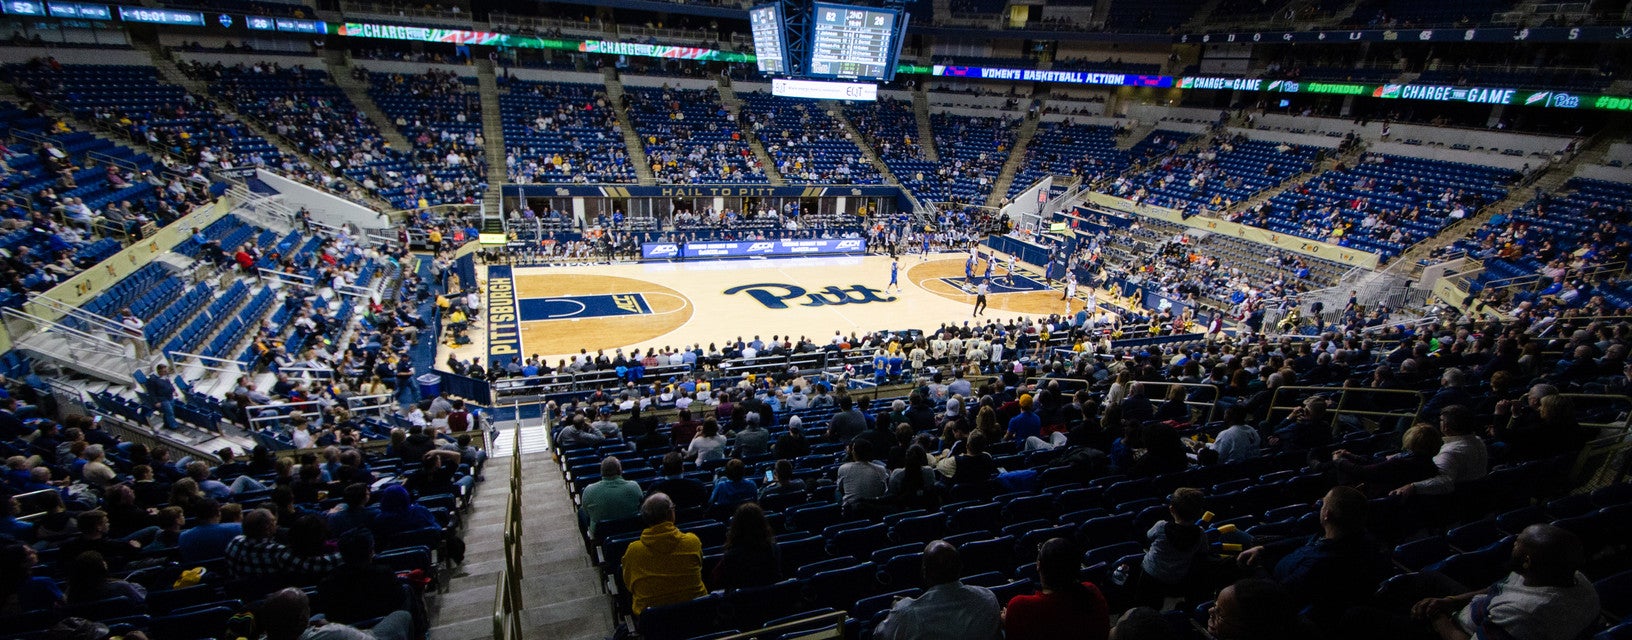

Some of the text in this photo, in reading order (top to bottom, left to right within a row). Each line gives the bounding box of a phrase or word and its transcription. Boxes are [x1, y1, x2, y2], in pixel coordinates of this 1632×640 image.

[14, 2, 35, 14] 52
[133, 10, 192, 22] 19:01 2ND
[849, 11, 863, 19] 2ND
[874, 16, 885, 26] 26
[254, 19, 267, 29] 26
[600, 41, 638, 55] CHARGE
[981, 67, 1020, 80] WOMEN'S
[1023, 70, 1082, 83] BASKETBALL
[1085, 72, 1125, 85] ACTION!
[1193, 77, 1224, 89] CHARGE
[1233, 79, 1262, 91] GAME
[846, 86, 863, 97] EQT
[1402, 86, 1451, 101] CHARGE
[1467, 89, 1516, 105] GAME
[662, 188, 775, 196] HAIL TO PITT
[746, 242, 775, 252] ACCN
[835, 240, 861, 249] ACCN
[723, 283, 897, 309] Pitt
[612, 294, 641, 313] ACC
[489, 277, 518, 355] PITTSBURGH
